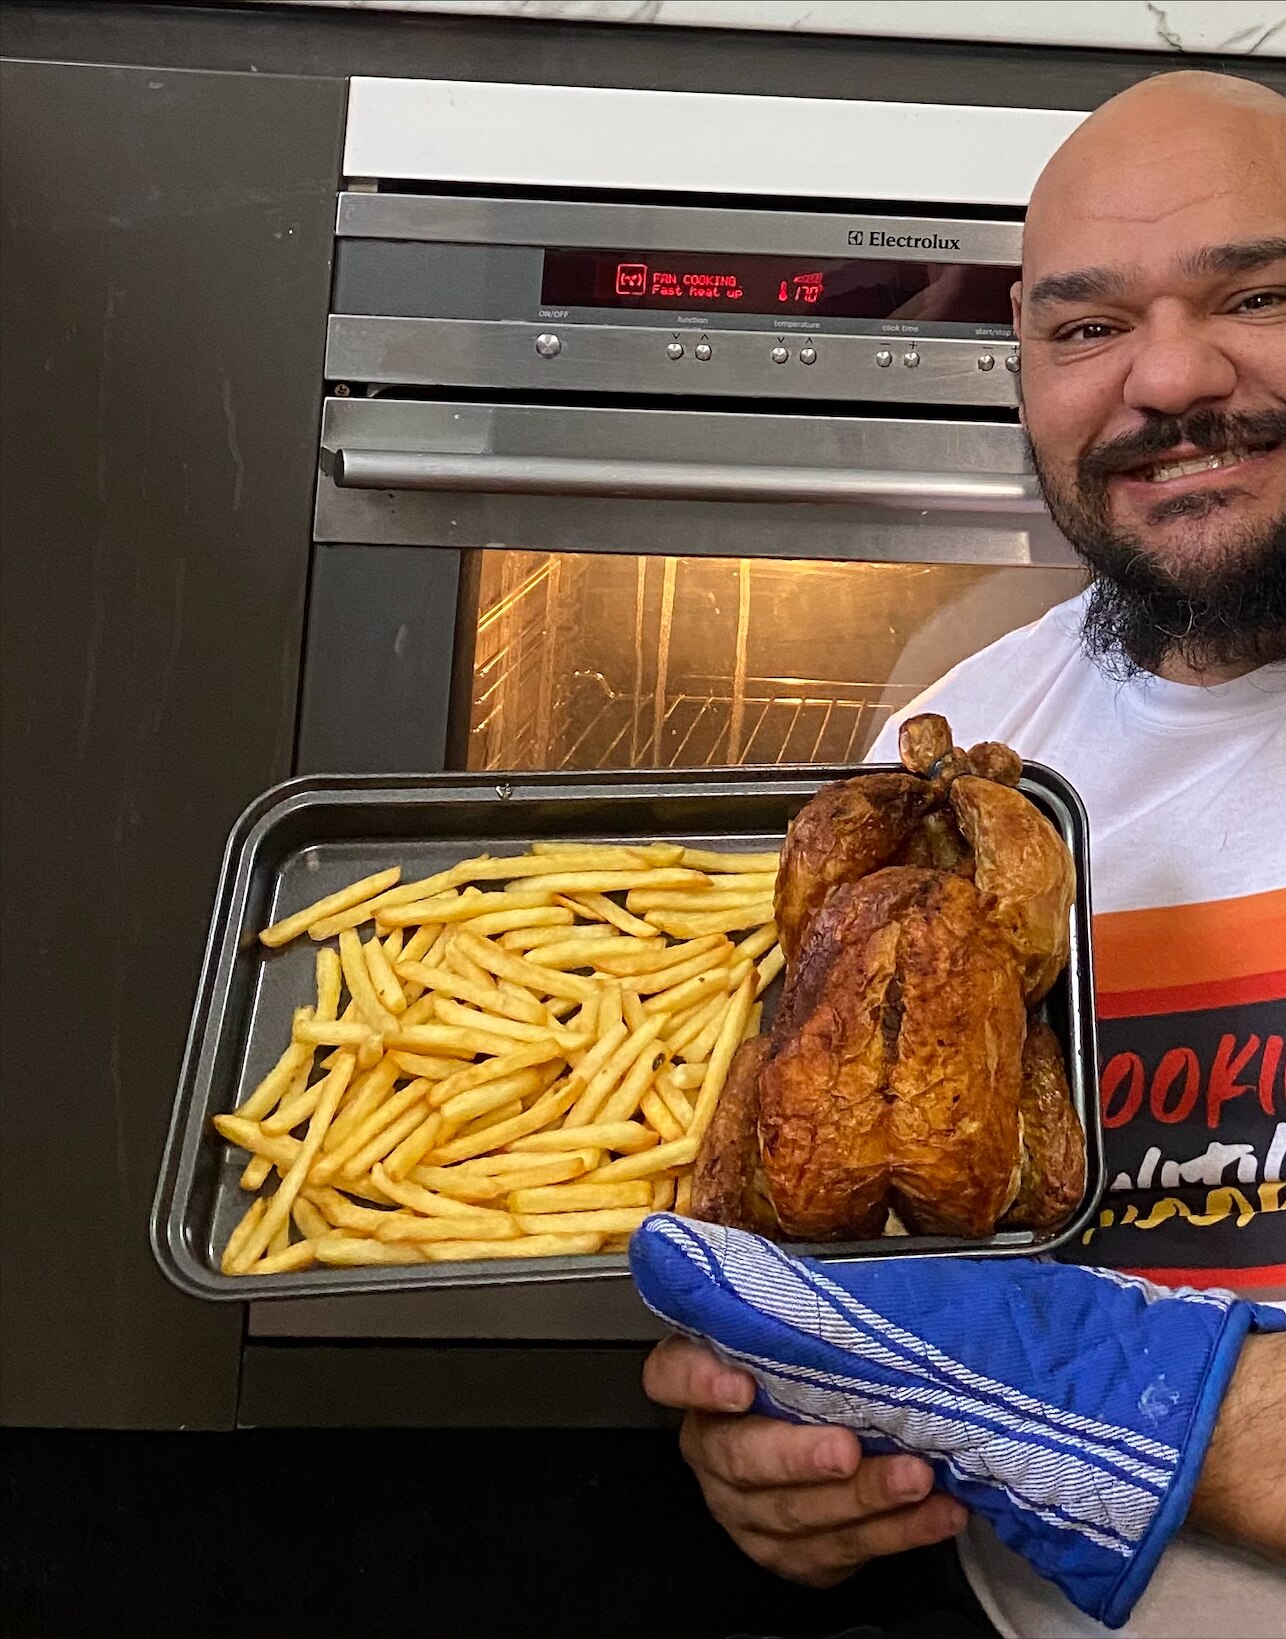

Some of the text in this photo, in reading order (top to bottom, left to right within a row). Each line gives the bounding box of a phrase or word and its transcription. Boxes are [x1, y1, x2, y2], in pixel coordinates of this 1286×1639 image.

[869, 231, 961, 250] Electrolux
[653, 272, 737, 287] FAN COOKING
[651, 284, 743, 299] Fast heat up
[538, 309, 569, 319] ON/OFF
[677, 315, 708, 325] function
[773, 320, 821, 330] temperature
[881, 324, 920, 334] cook time
[975, 328, 1012, 338] start/stop
